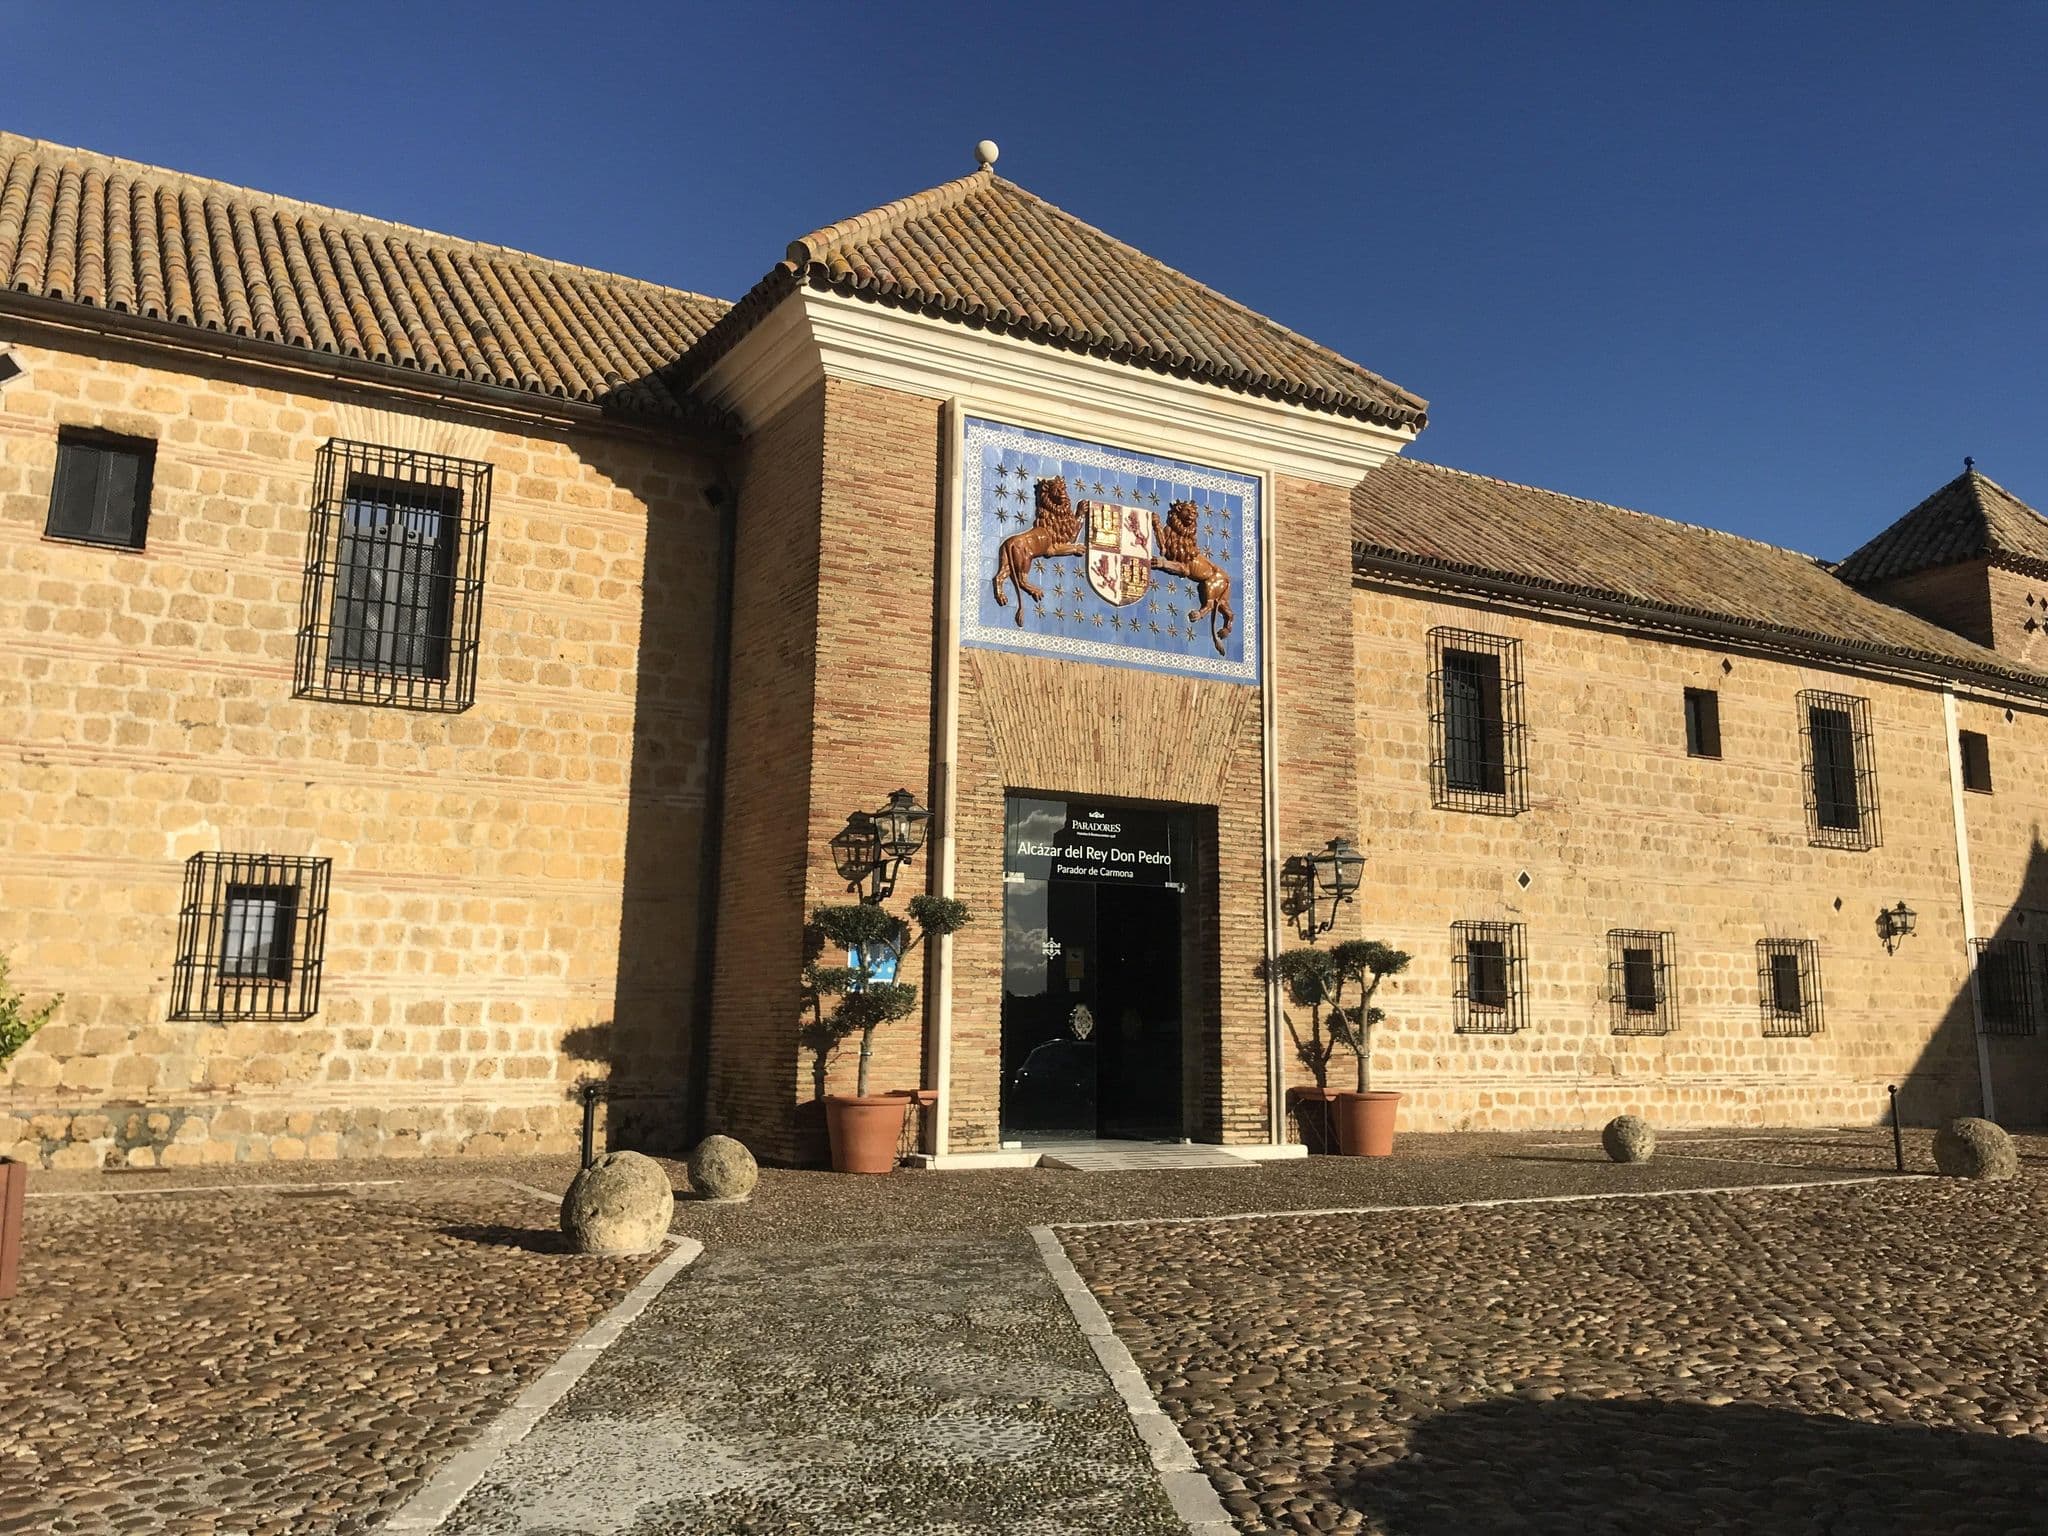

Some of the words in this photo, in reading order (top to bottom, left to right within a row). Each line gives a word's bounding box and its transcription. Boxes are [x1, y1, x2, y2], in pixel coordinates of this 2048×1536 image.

[1072, 820, 1121, 833] PARADORES
[1018, 842, 1061, 857] Alcázar
[1065, 845, 1082, 858] del
[1087, 847, 1108, 863] Rey
[1111, 849, 1135, 862] Don
[1139, 851, 1171, 865] Pedro
[1057, 865, 1086, 875] Parador
[1089, 866, 1098, 876] de
[1100, 868, 1133, 878] Carmona
